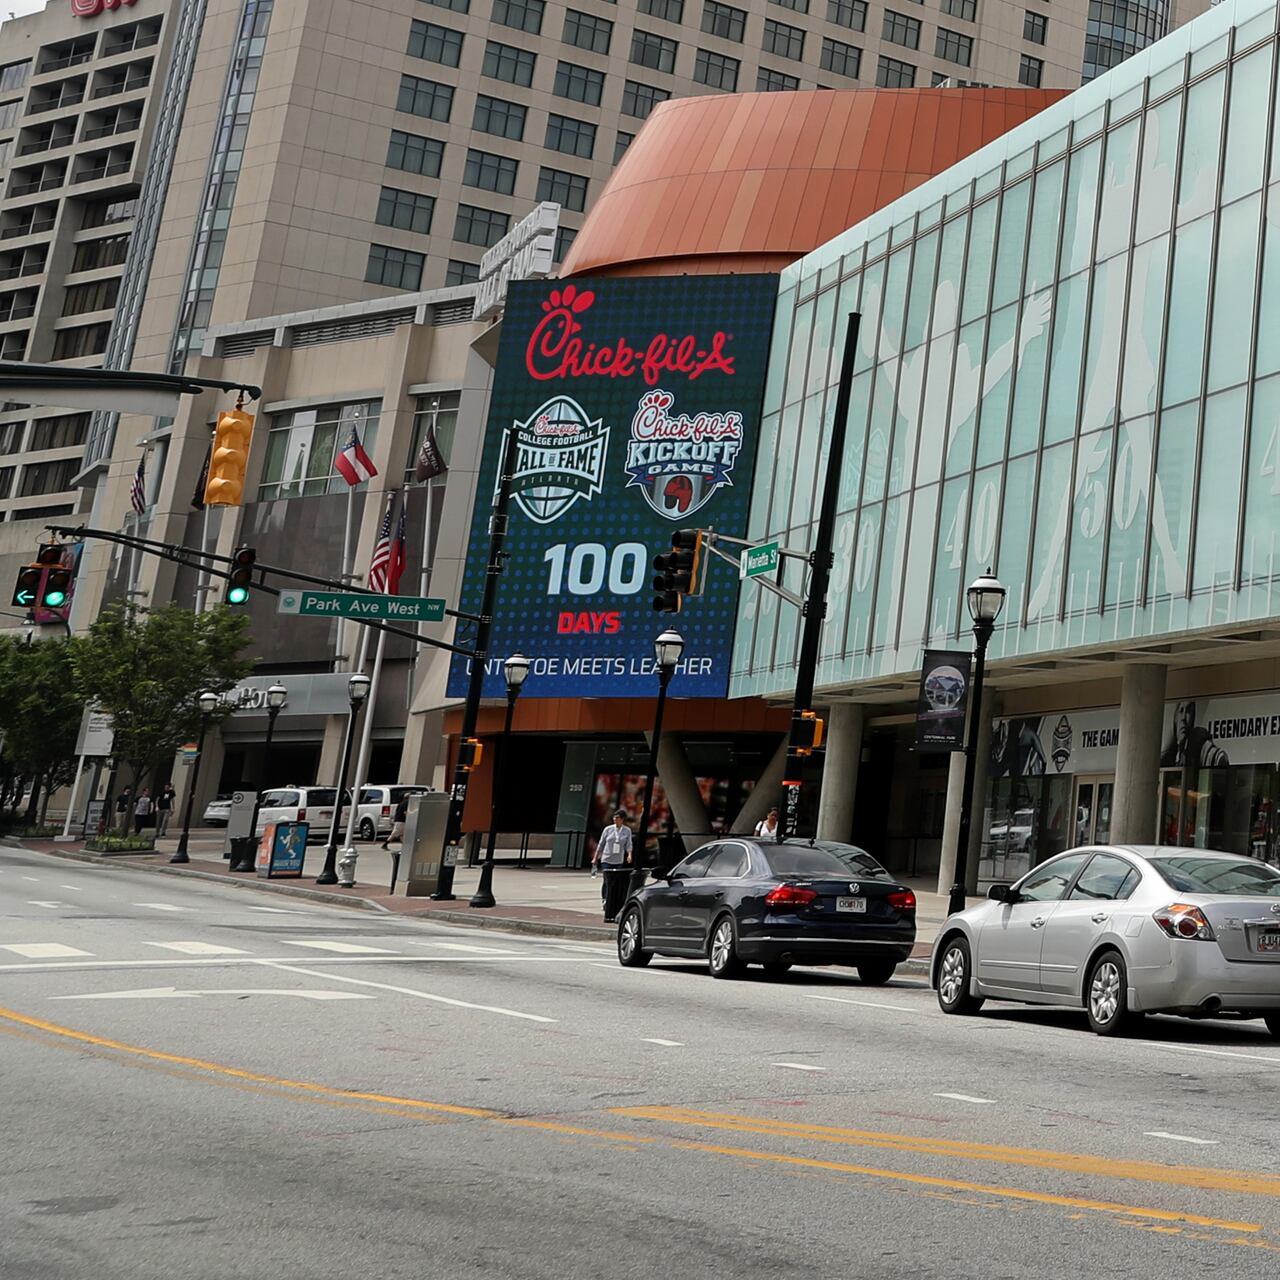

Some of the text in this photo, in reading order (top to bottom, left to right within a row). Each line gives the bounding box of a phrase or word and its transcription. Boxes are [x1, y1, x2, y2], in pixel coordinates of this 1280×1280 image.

[525, 284, 735, 386] Chick-fil-A
[635, 393, 740, 441] Chick-fil-A
[518, 430, 594, 446] COLLEGE FOOTBALL
[518, 449, 546, 473] ALL
[557, 443, 599, 476] FAME
[628, 441, 739, 469] KICKOFF
[648, 463, 715, 475] GAME
[544, 542, 648, 596] 100
[748, 552, 768, 570] Marietta
[305, 596, 440, 616] Park Ave West NW
[557, 611, 621, 634] DAYS
[563, 658, 625, 675] MEETS
[630, 658, 712, 675] LEAHER
[1082, 730, 1099, 748] THE
[1100, 728, 1119, 747] GAM
[1208, 716, 1269, 739] LEGENDARY
